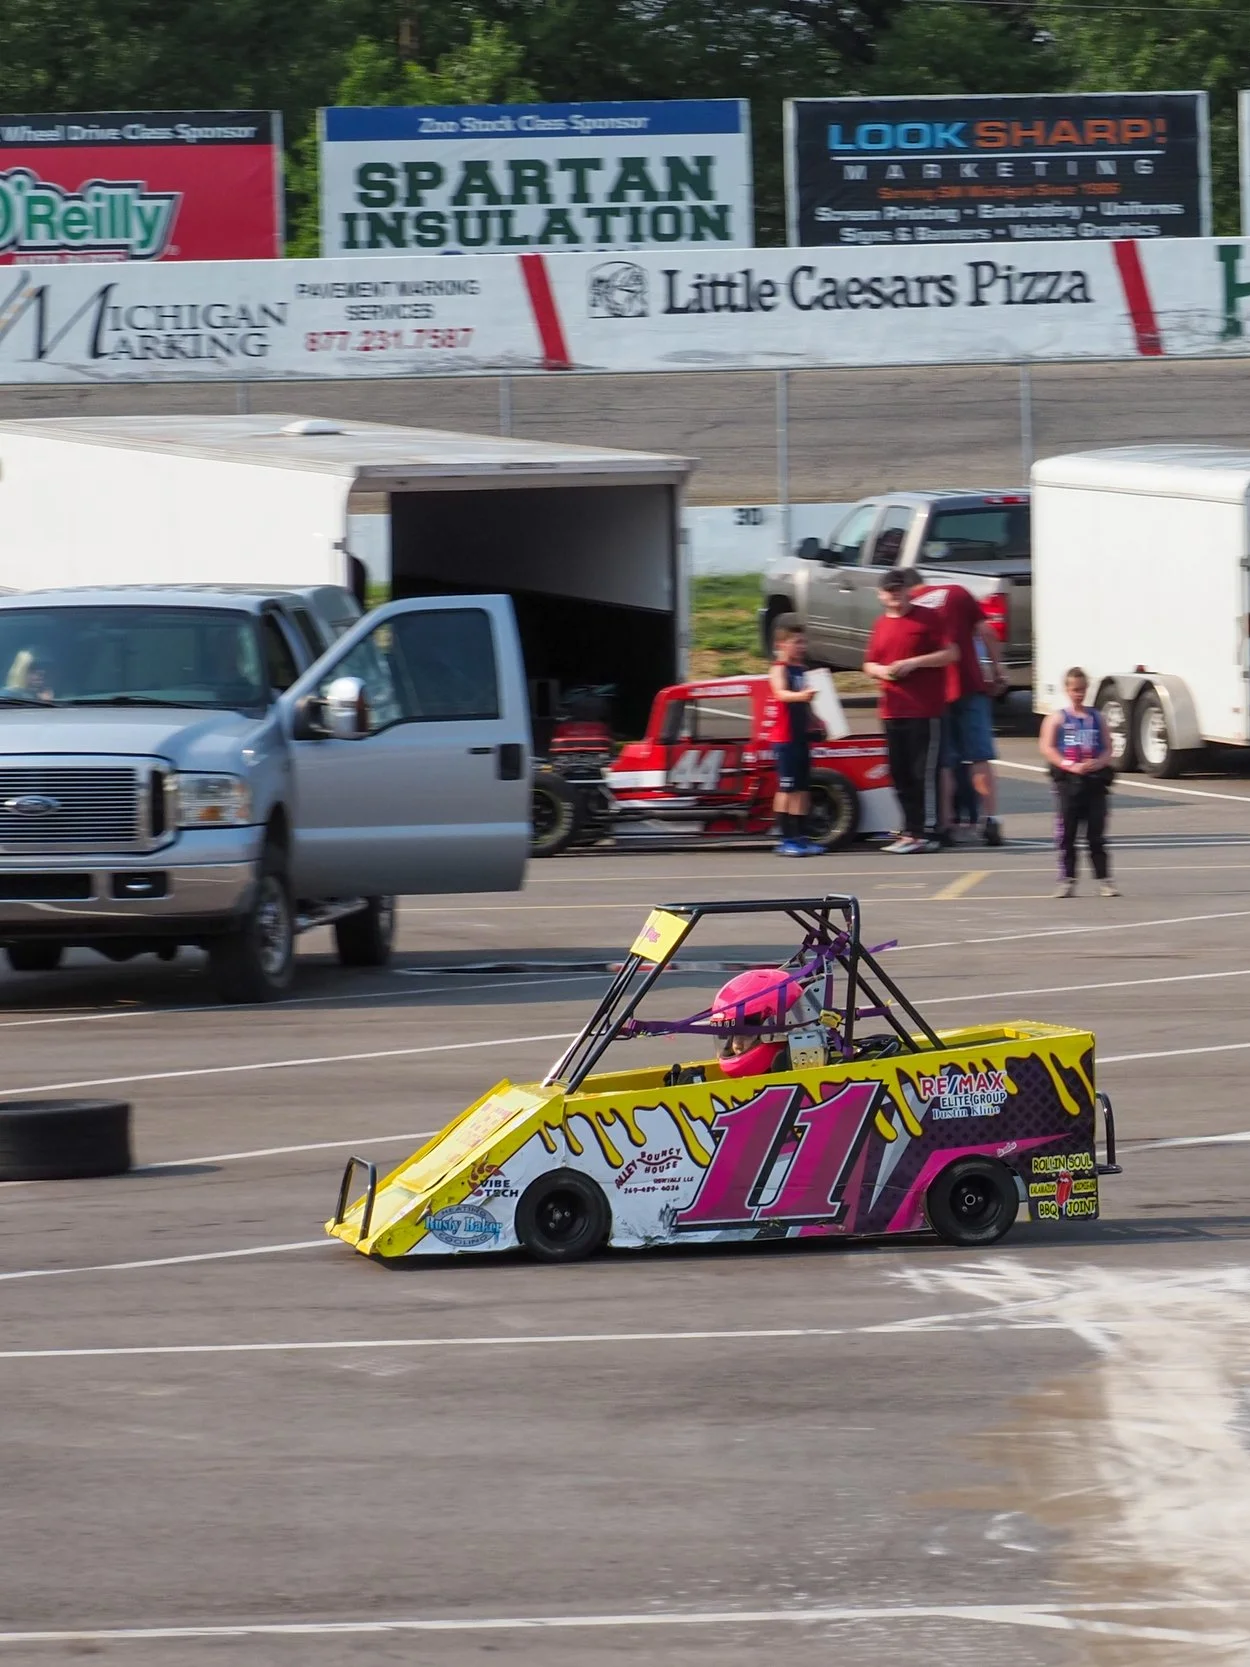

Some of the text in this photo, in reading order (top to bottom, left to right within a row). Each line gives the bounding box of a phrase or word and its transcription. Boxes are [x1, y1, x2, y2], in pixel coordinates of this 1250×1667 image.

[121, 124, 174, 140] Class
[174, 123, 257, 143] Sponsor
[518, 115, 568, 131] Class
[570, 115, 650, 134] Sponsor
[827, 117, 1168, 152] LOOK SHARP!
[842, 159, 1155, 181] MARKETING
[355, 155, 717, 208] SPARTAN
[341, 205, 733, 250] INSULATION
[661, 260, 1094, 315] Little Caesars Pizza
[667, 749, 726, 791] 44
[921, 1072, 1005, 1097] RE/MAX
[941, 1092, 1006, 1108] ELITE GROUP
[640, 1147, 681, 1161] BOUNCY
[673, 1081, 884, 1222] 11
[1067, 1152, 1093, 1170] SOUL
[614, 1159, 638, 1190] ALLEY
[644, 1161, 678, 1174] HOUSE
[480, 1179, 511, 1188] VIBE
[484, 1189, 519, 1198] TECH
[1039, 1197, 1096, 1219] BBQ JOINT
[424, 1216, 461, 1235] Rusty
